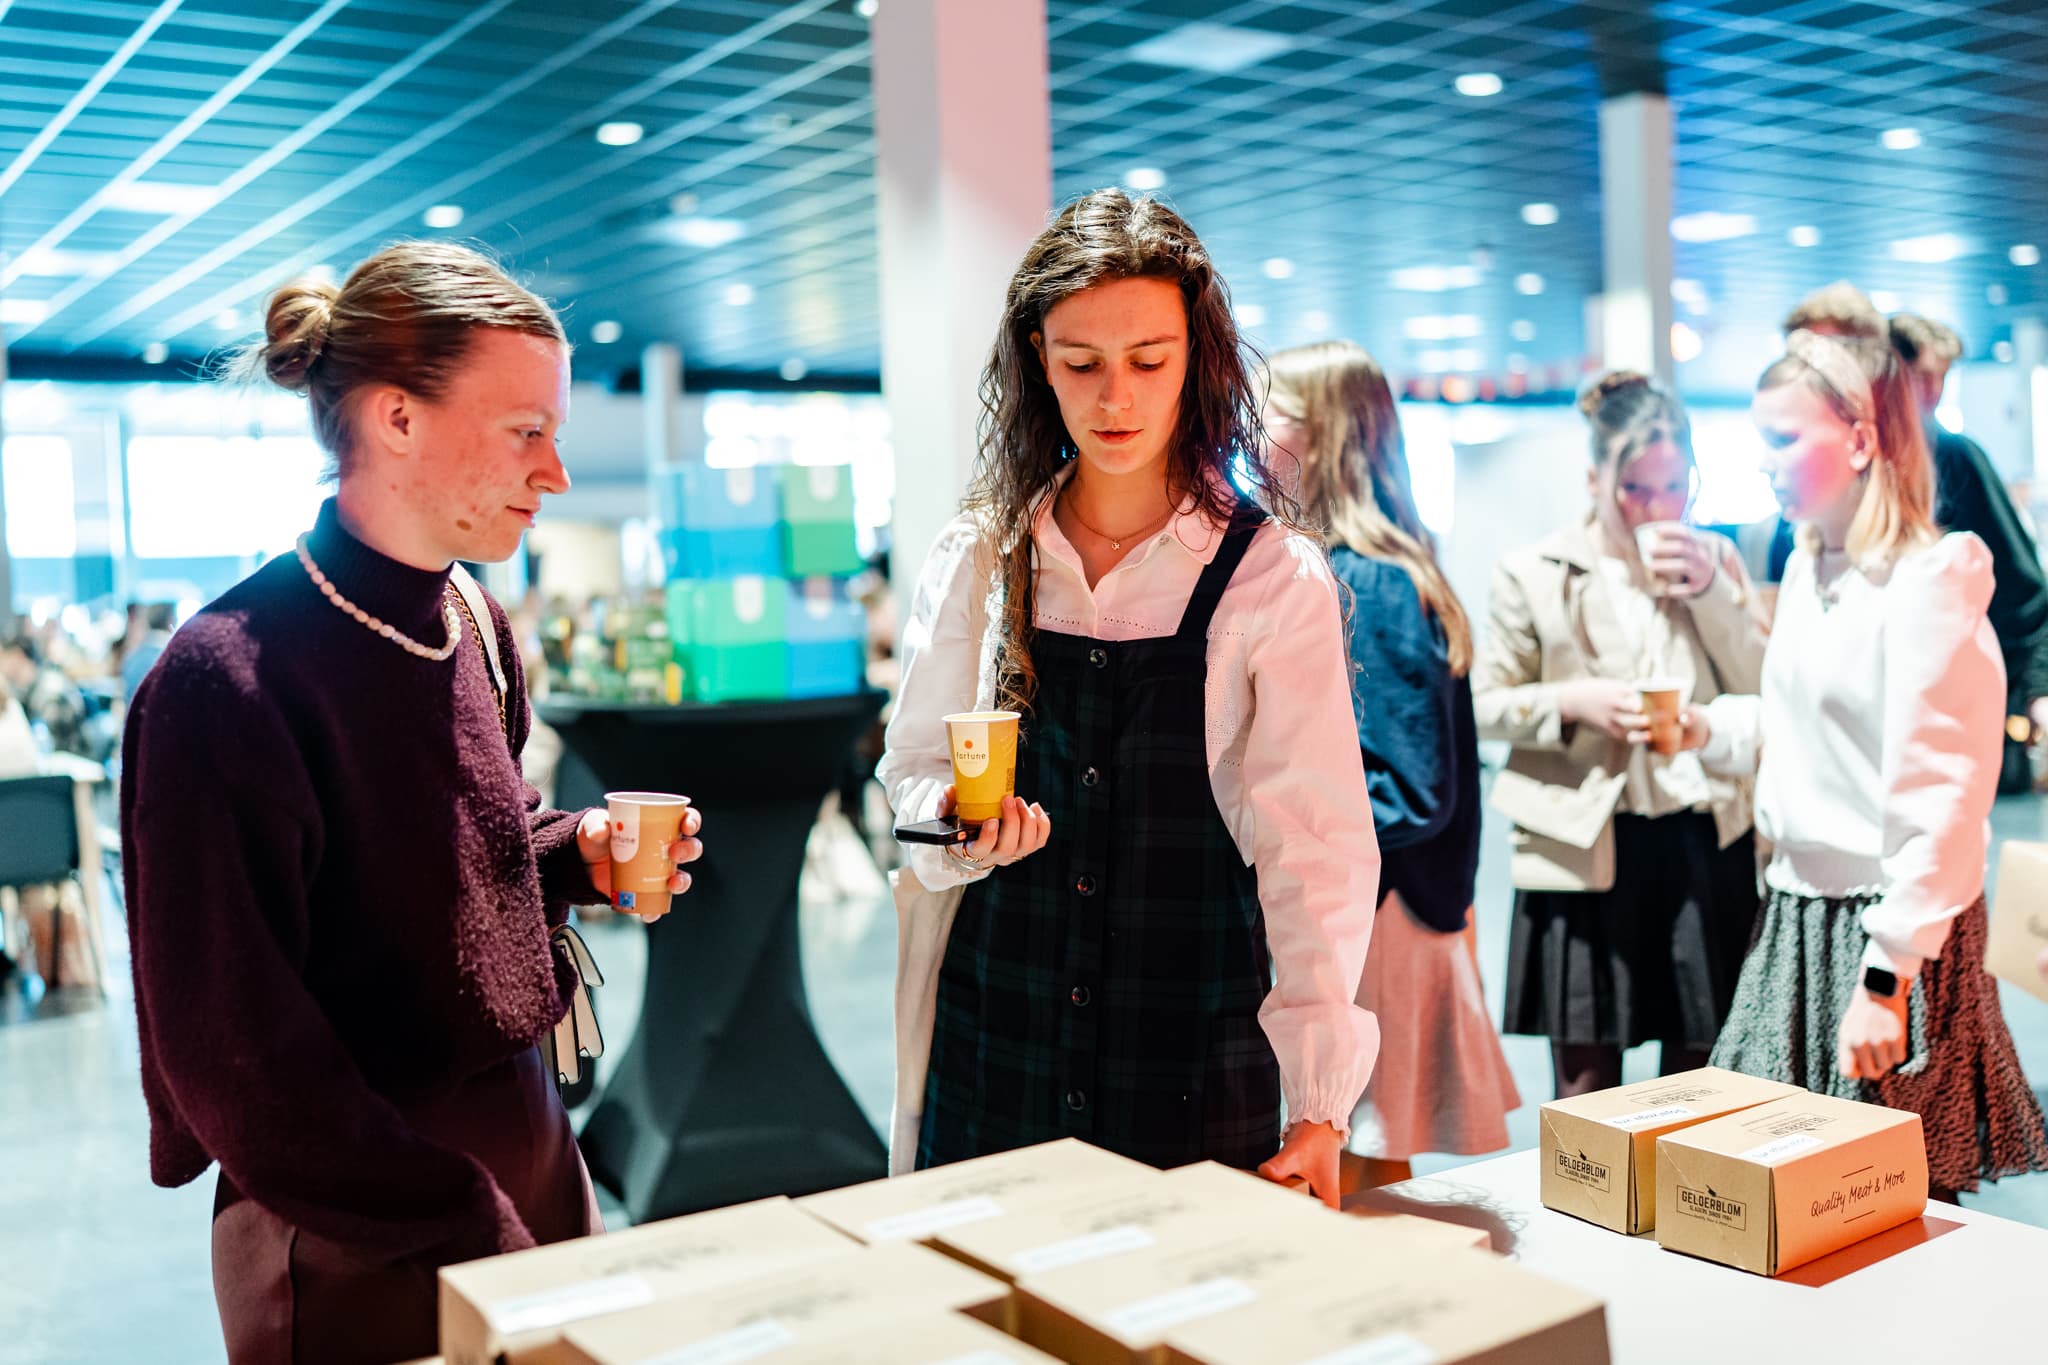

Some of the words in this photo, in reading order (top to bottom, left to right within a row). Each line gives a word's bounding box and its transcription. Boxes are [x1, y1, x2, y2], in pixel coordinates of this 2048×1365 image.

[956, 751, 986, 760] fortune
[1559, 1154, 1606, 1180] GELDERBLOM
[1681, 1190, 1741, 1217] GELDERBLOM
[1811, 1191, 1846, 1217] Quality
[1849, 1179, 1873, 1205] Meat
[1874, 1177, 1881, 1193] &
[1884, 1170, 1906, 1191] More
